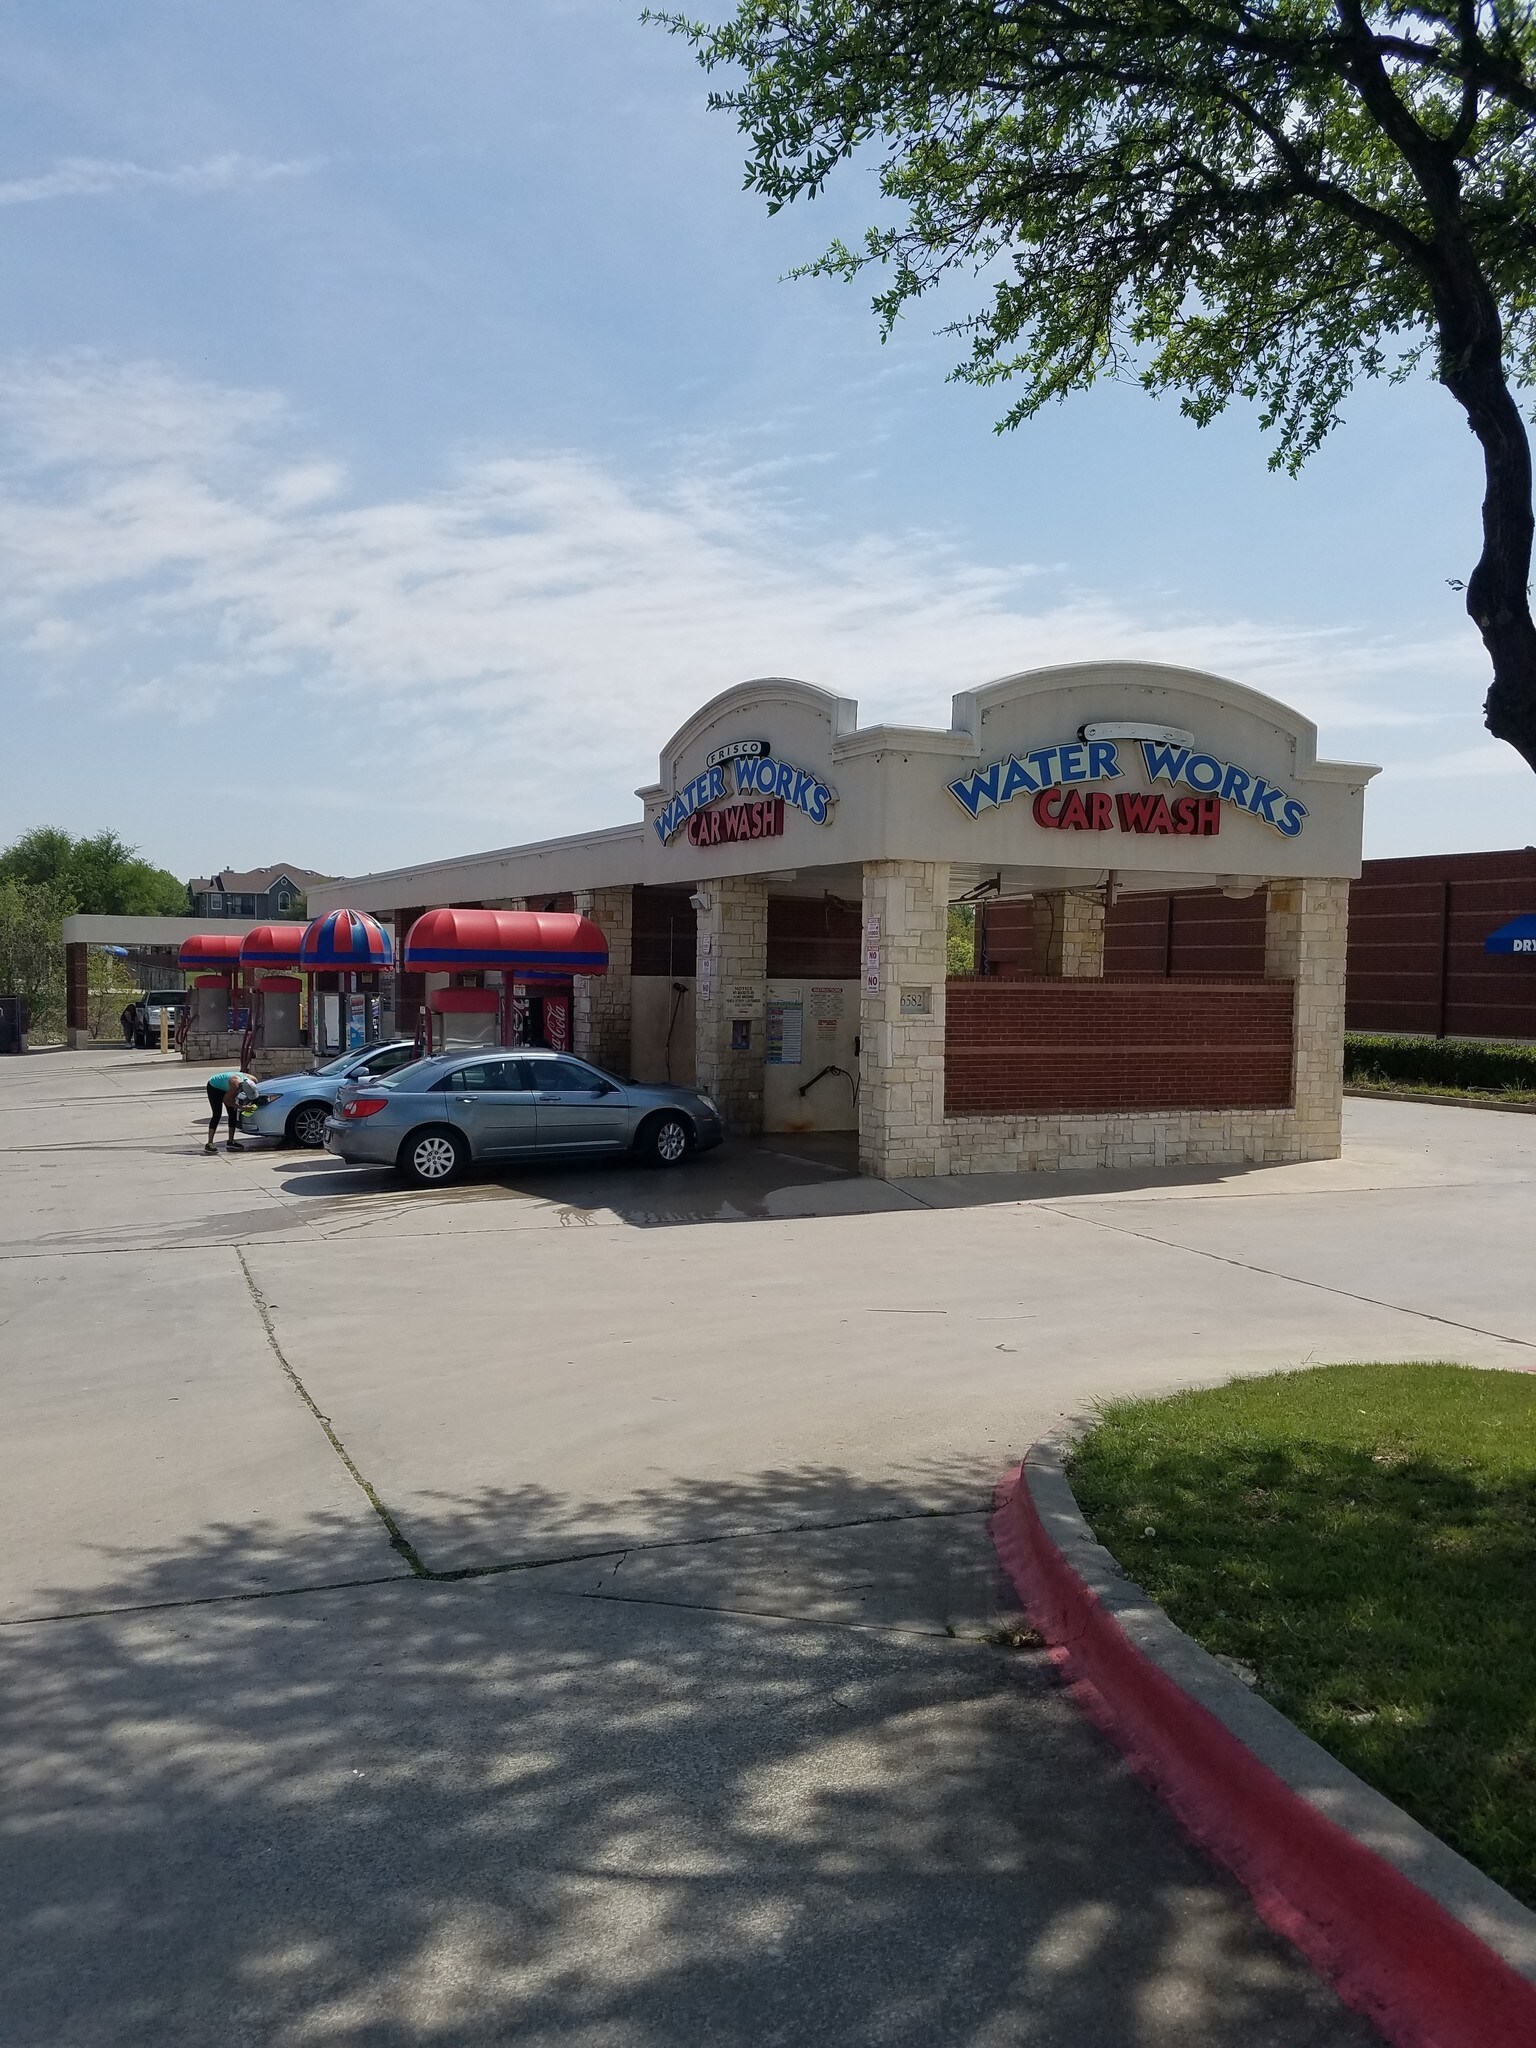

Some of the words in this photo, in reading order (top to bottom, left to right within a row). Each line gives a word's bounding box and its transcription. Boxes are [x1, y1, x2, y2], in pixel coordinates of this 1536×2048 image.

[710, 742, 759, 764] FRISCO
[654, 766, 727, 845] WATER
[734, 756, 831, 825] WORKS
[949, 741, 1124, 819] WATER
[1141, 741, 1309, 837] WORKS
[688, 810, 721, 846] CAR
[724, 799, 779, 842] WASH
[1034, 789, 1113, 831] CAR
[1117, 792, 1220, 836] WASH
[869, 952, 877, 960] NO
[868, 976, 878, 986] NO
[900, 994, 922, 1007] 6582
